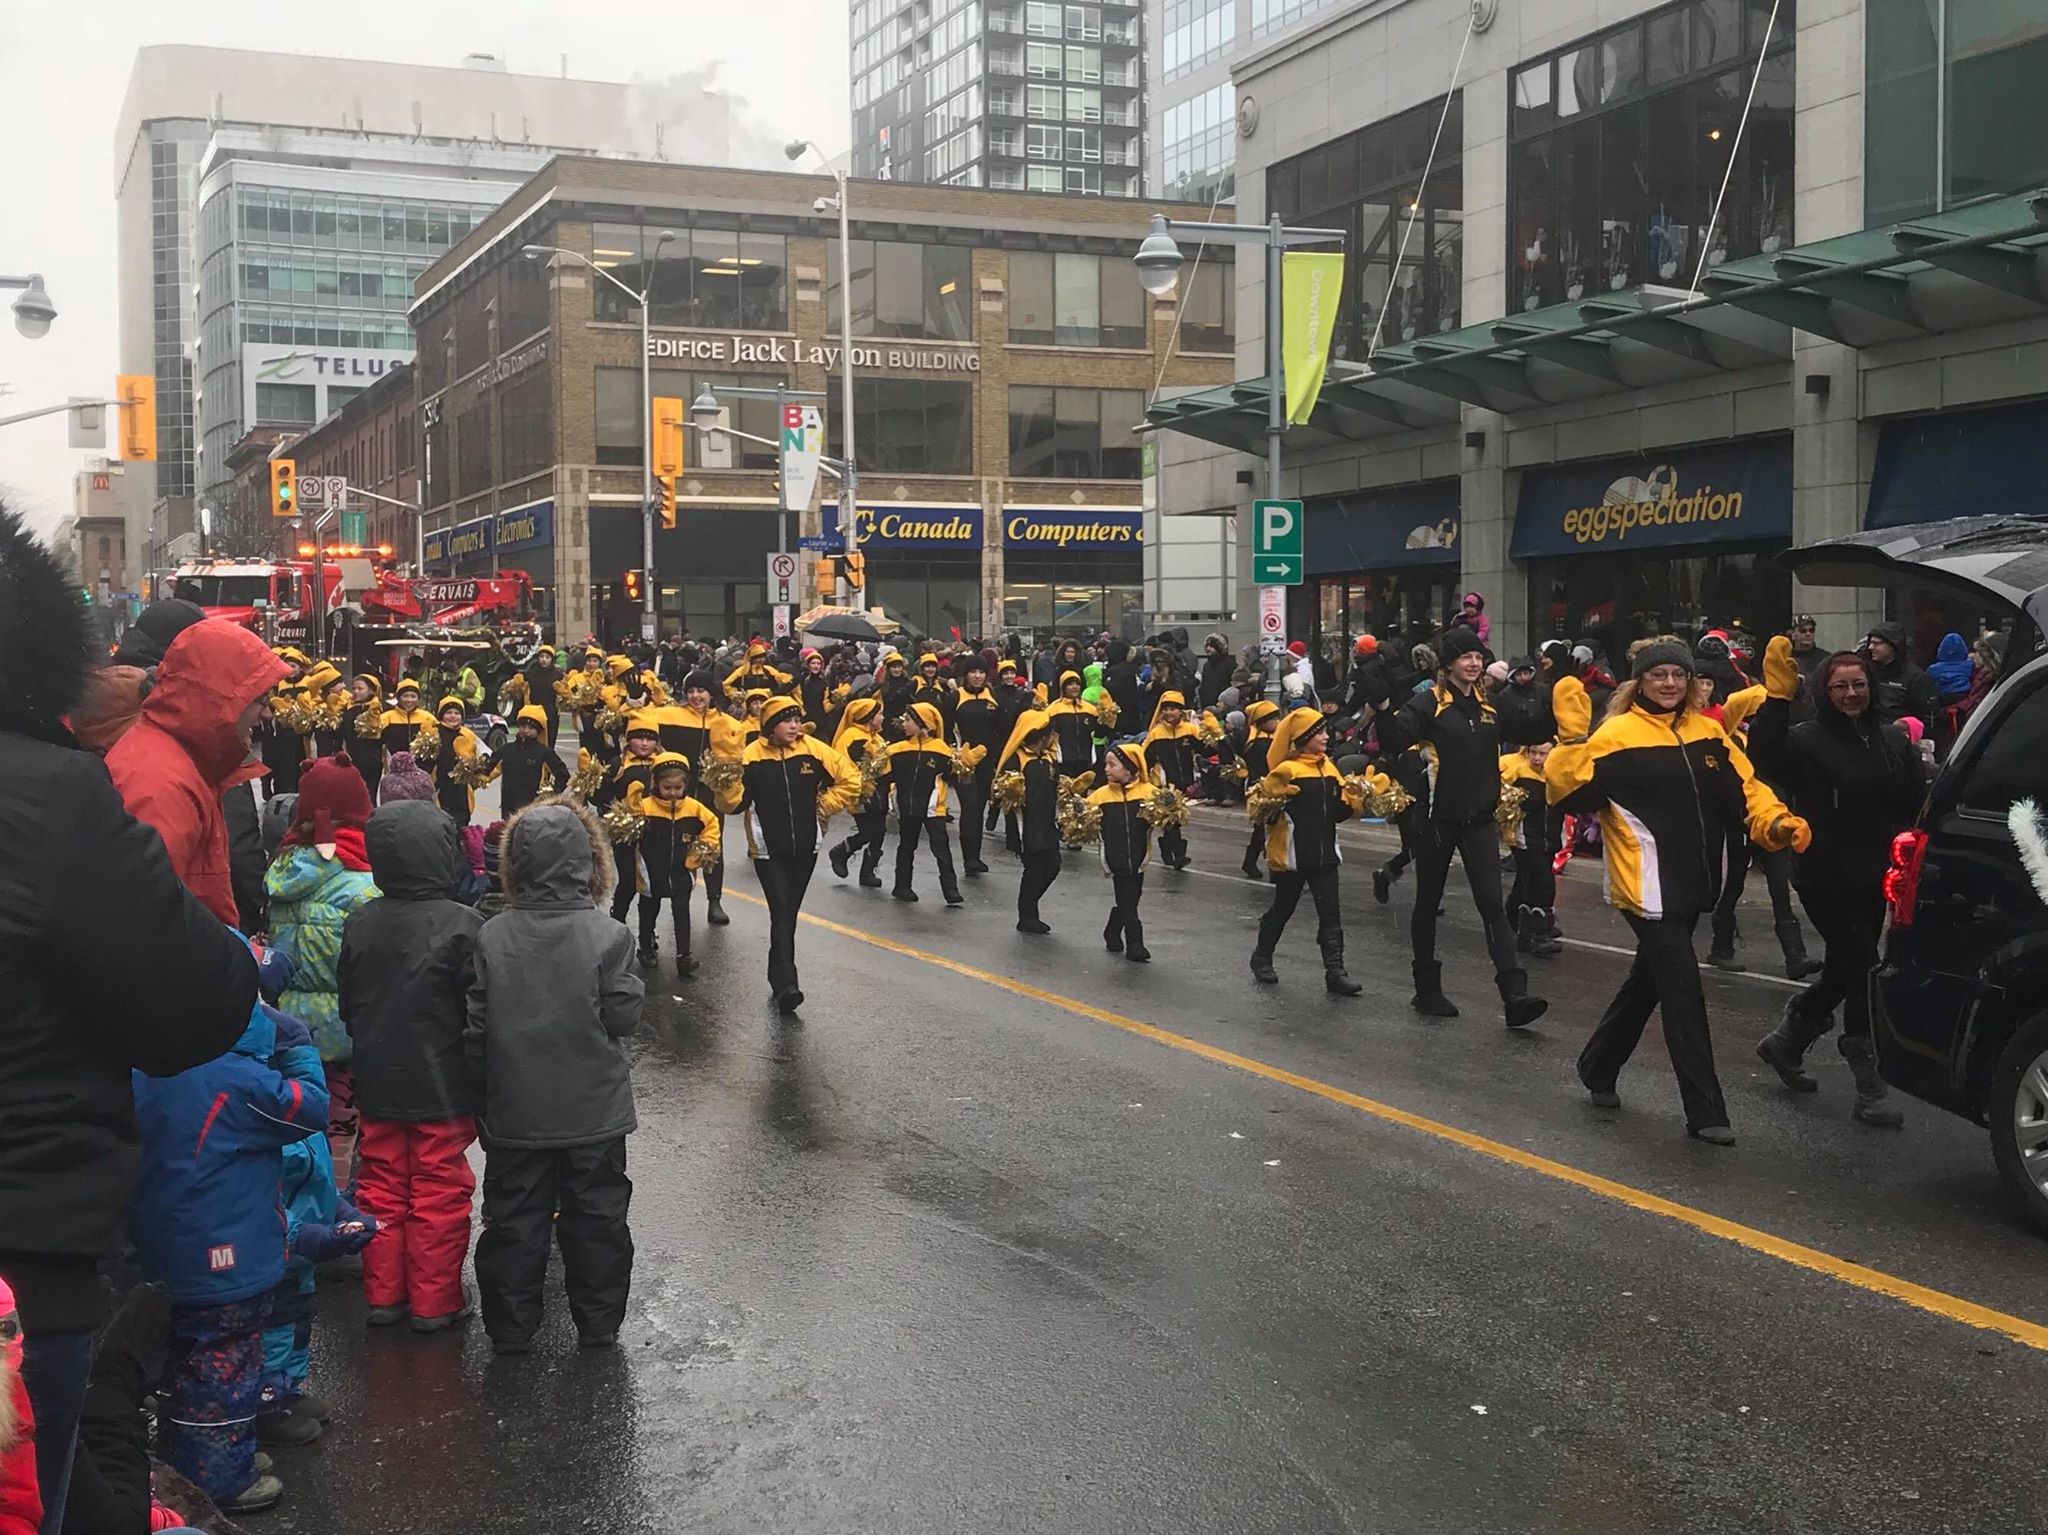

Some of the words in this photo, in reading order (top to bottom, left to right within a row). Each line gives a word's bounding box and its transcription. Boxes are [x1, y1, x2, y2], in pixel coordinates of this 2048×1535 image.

[731, 336, 787, 364] Jack
[791, 339, 881, 371] Layon
[888, 350, 981, 371] BUILDING
[880, 514, 973, 540] Canada
[1008, 517, 1131, 547] Computers
[1263, 506, 1294, 551] P
[1563, 485, 1742, 543] eggspectation
[211, 1247, 235, 1269] M
